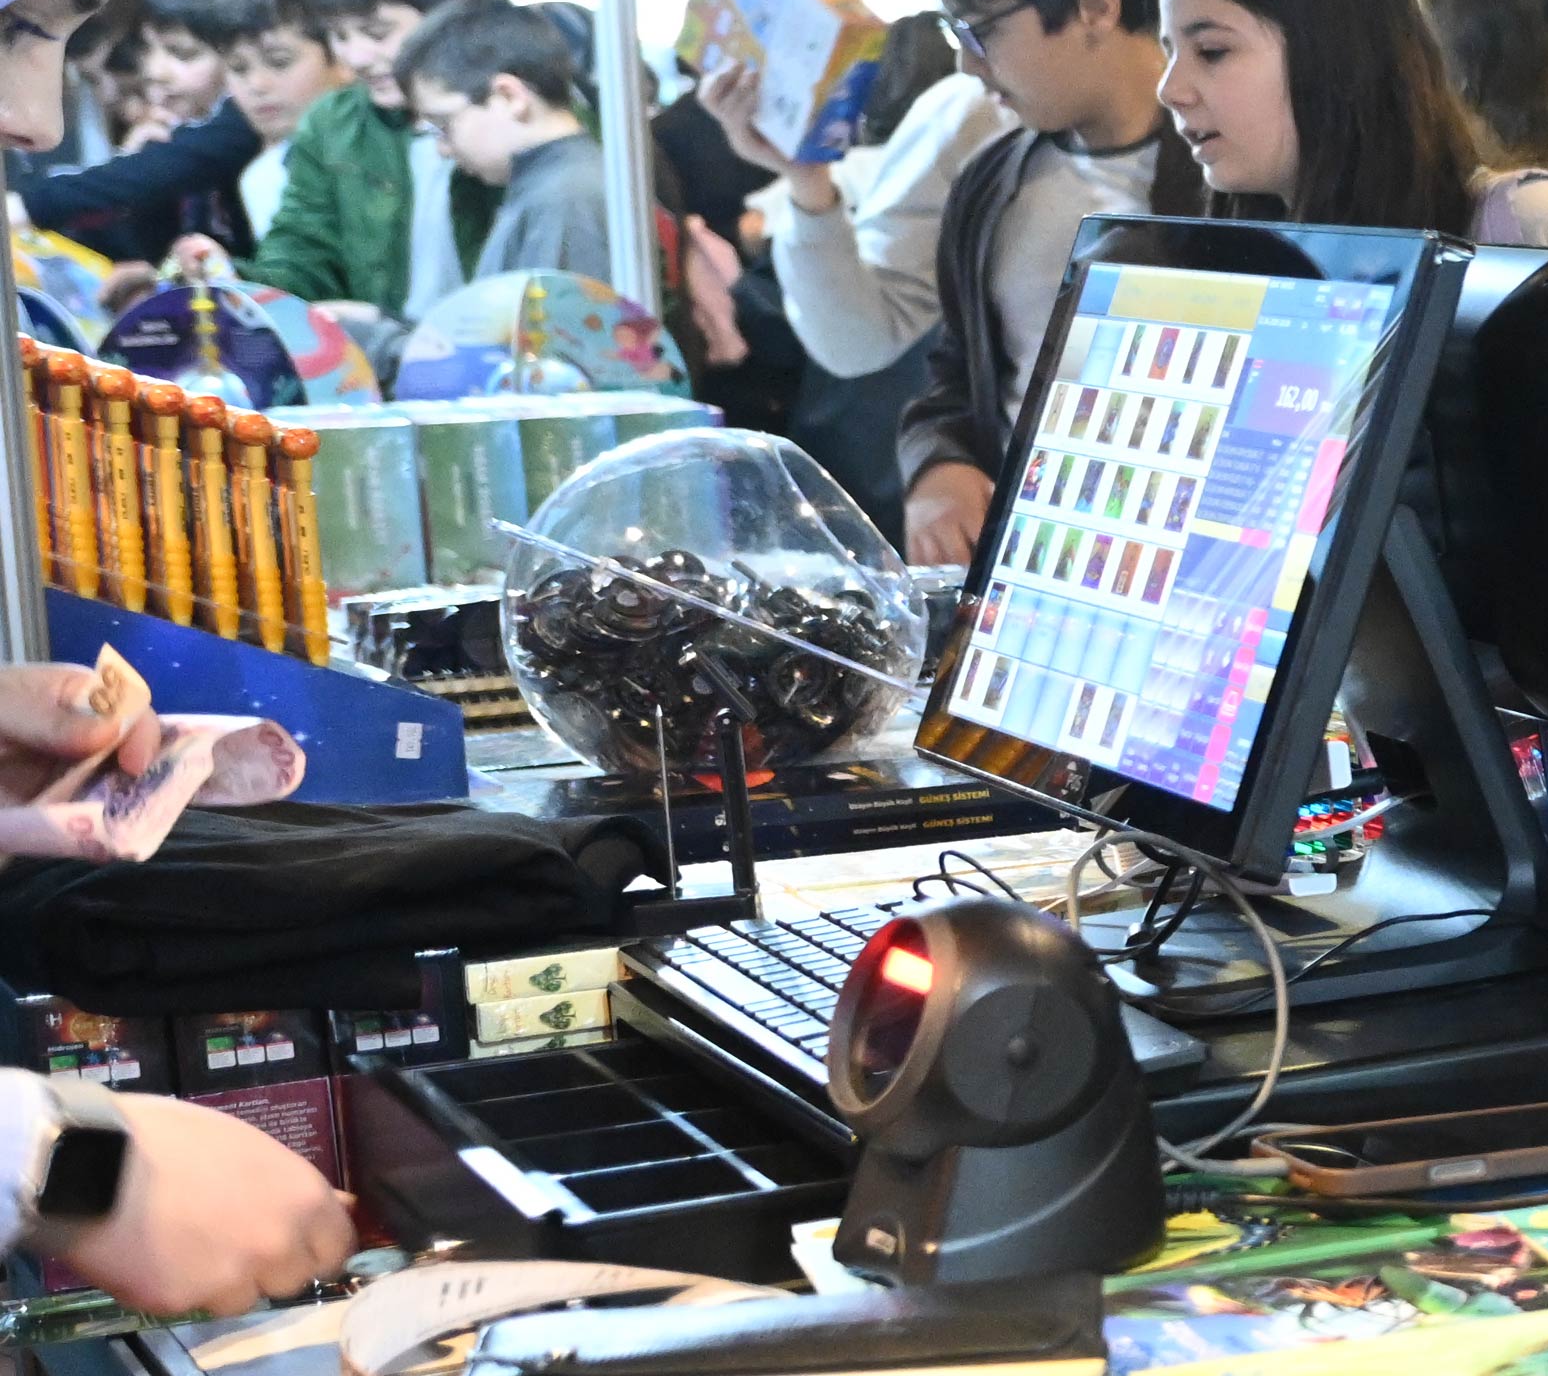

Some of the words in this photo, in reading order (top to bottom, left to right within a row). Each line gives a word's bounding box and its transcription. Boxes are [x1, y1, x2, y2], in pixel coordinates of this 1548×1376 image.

[919, 794, 950, 805] GÜNEŞ
[952, 790, 990, 802] SİSTEMİ
[922, 819, 954, 829] GÜNEŞ
[955, 814, 994, 826] SİSTEMİ
